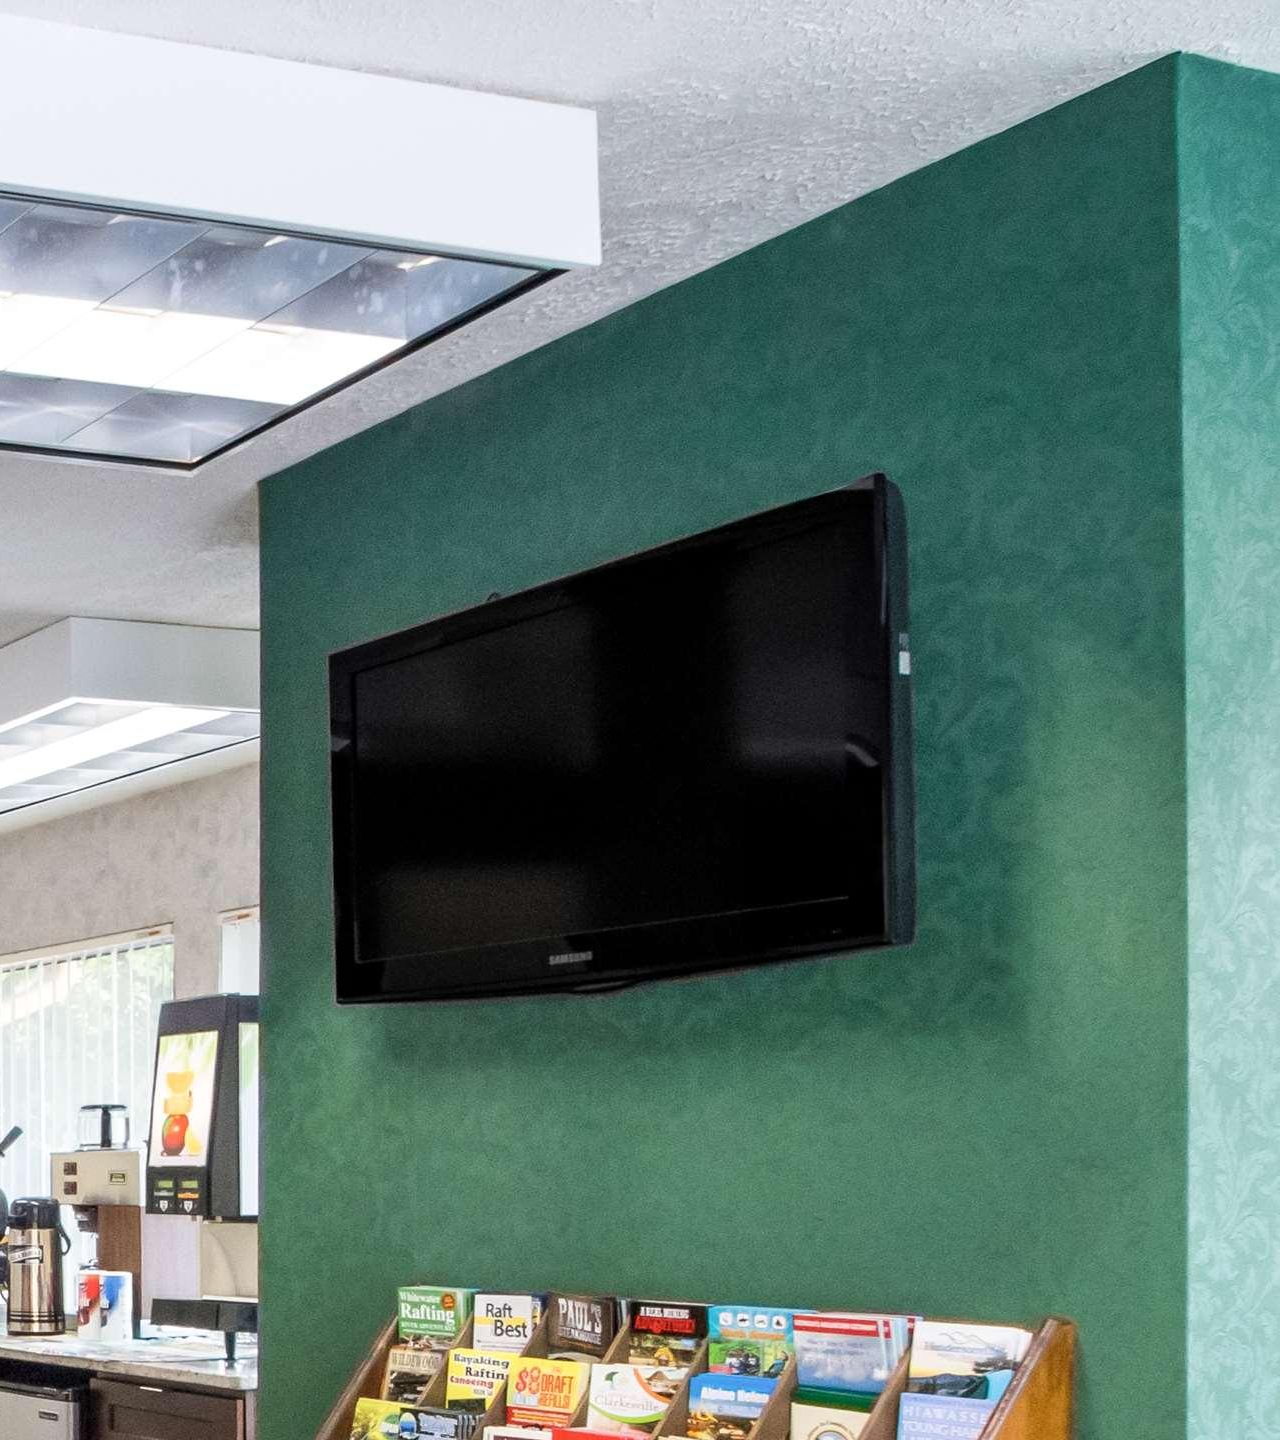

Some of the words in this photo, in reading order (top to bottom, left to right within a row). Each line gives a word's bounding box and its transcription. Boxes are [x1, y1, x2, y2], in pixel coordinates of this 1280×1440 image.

[400, 1291, 440, 1304] Whitewater
[400, 1302, 455, 1326] Rafting
[485, 1303, 513, 1319] Raft
[558, 1298, 602, 1333] PAUL'S
[494, 1319, 528, 1338] Best
[453, 1353, 510, 1369] Kayaking
[449, 1375, 494, 1390] Canoeing
[541, 1375, 574, 1394] DRAFT
[594, 1393, 659, 1413] Clarkesville
[701, 1386, 735, 1401] Alpine
[737, 1388, 769, 1403] Helen
[903, 1407, 988, 1425] HIAWASSE
